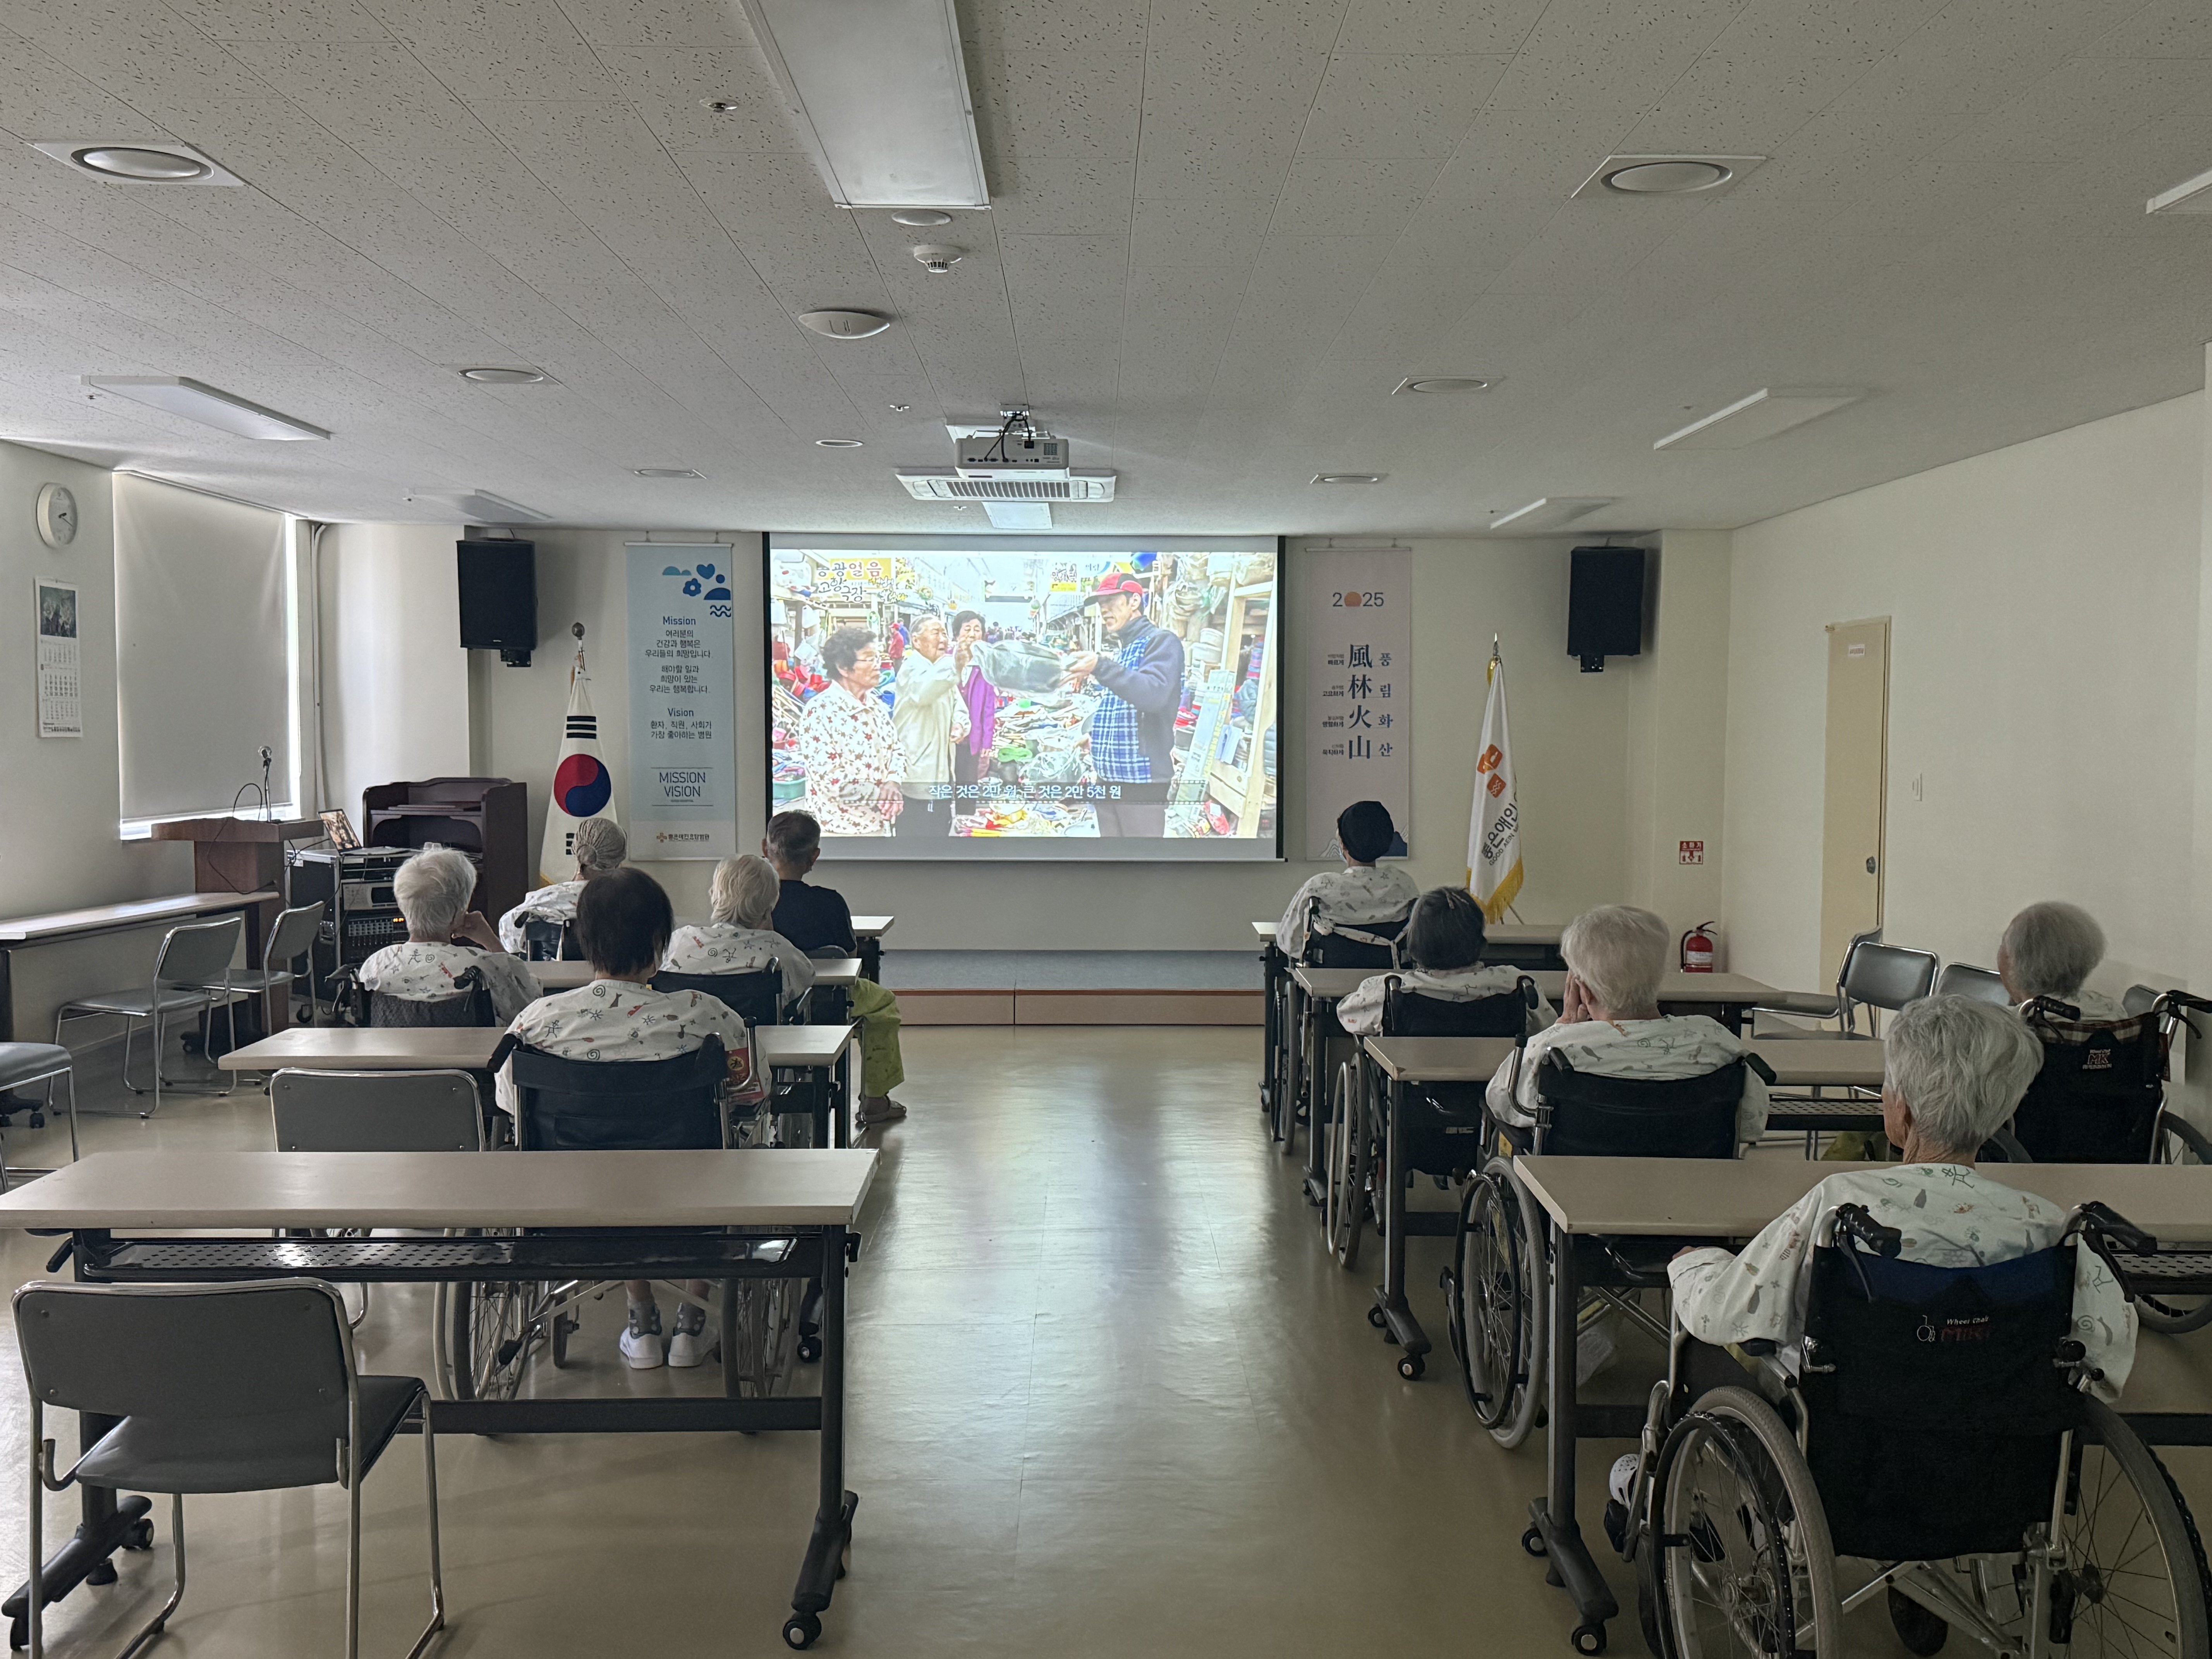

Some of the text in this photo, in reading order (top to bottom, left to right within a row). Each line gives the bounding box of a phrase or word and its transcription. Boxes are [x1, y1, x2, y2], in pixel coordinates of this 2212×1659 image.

[663, 616, 696, 625] Mission
[656, 639, 701, 649] 건강과 행복은
[661, 675, 698, 684] 희망이 있는
[649, 685, 671, 694] 우리는
[667, 708, 694, 717] Vision
[651, 731, 665, 739] 가장
[697, 731, 712, 739] 병원
[659, 771, 706, 784] MISSION
[664, 785, 701, 797] VISION
[929, 785, 953, 799] 작은
[956, 785, 979, 799] 것은
[982, 785, 1001, 799] 2만
[1022, 785, 1036, 799] 큰
[1039, 785, 1062, 799] 것은
[1065, 785, 1083, 799] 2만
[1087, 785, 1106, 799] 5천
[1109, 785, 1121, 799] 원
[1489, 848, 1503, 866] GOOD
